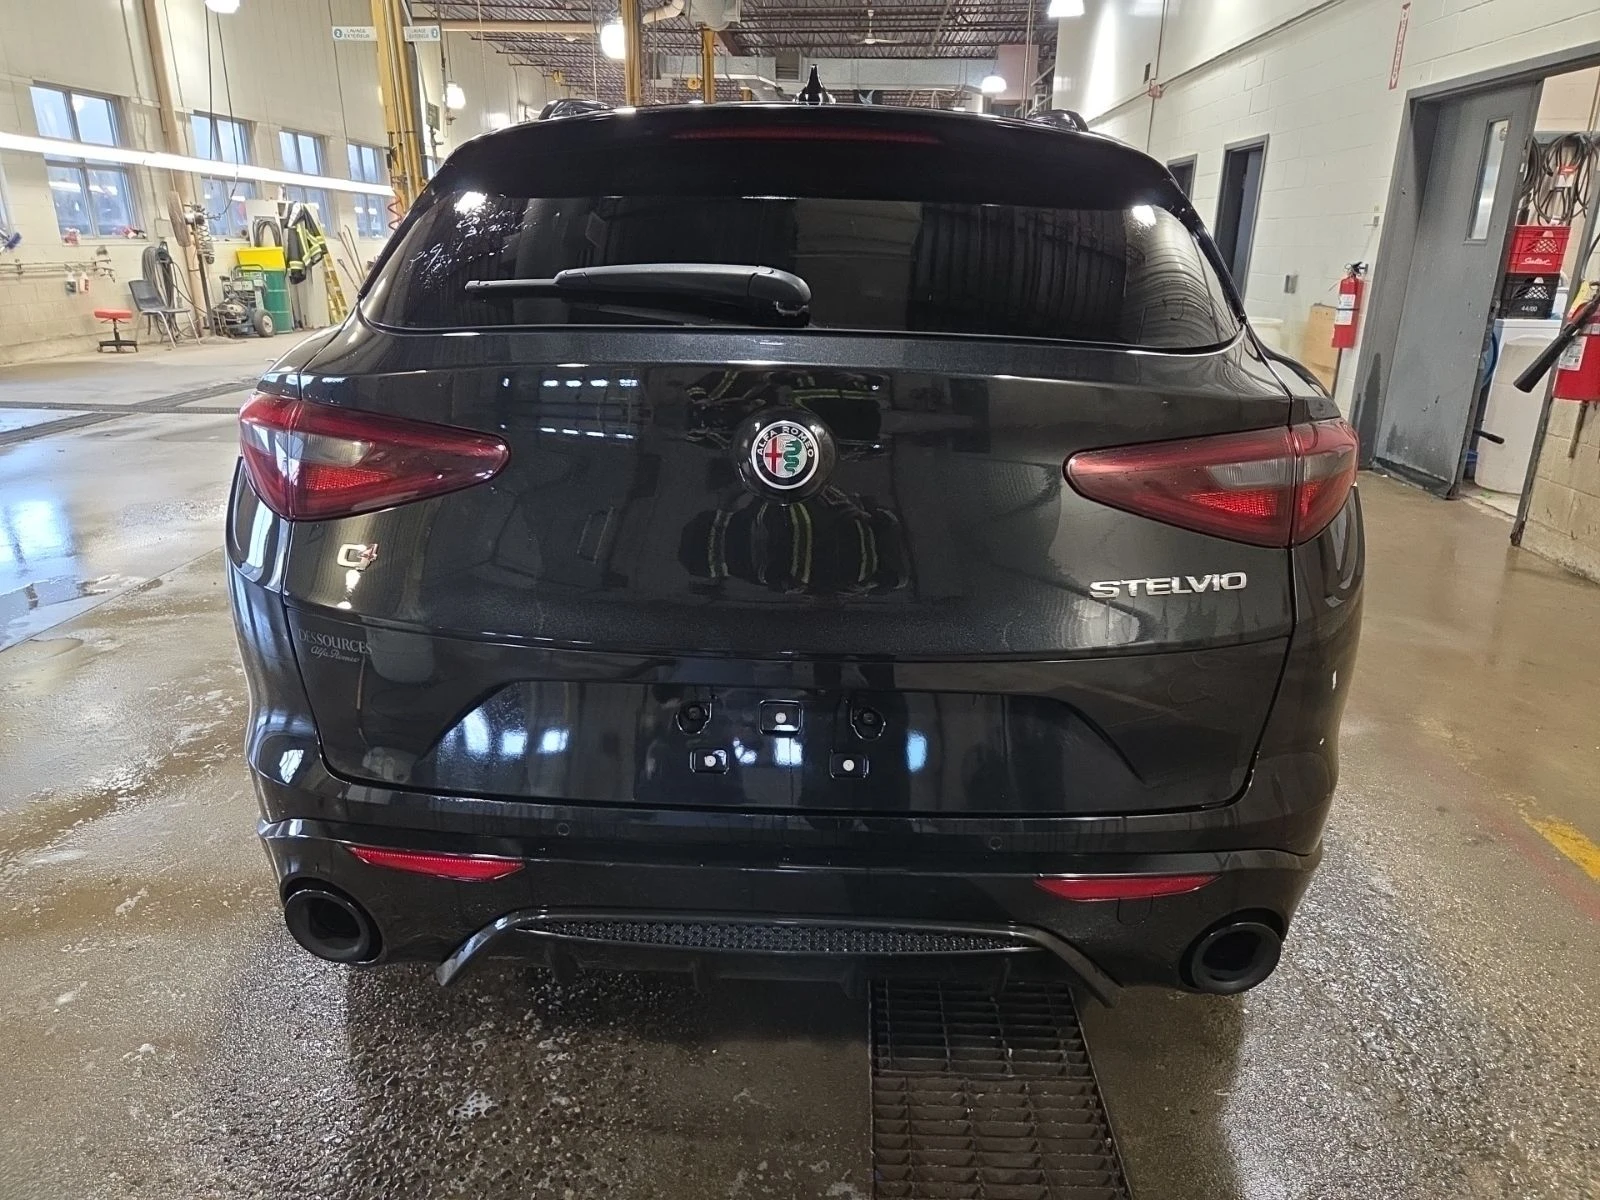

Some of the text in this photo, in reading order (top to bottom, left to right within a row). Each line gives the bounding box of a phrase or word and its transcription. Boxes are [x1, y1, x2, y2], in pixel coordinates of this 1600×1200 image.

[757, 426, 814, 458] ALFA ROMEO
[1089, 571, 1247, 598] STELVIO
[299, 629, 373, 655] DESSOURCES
